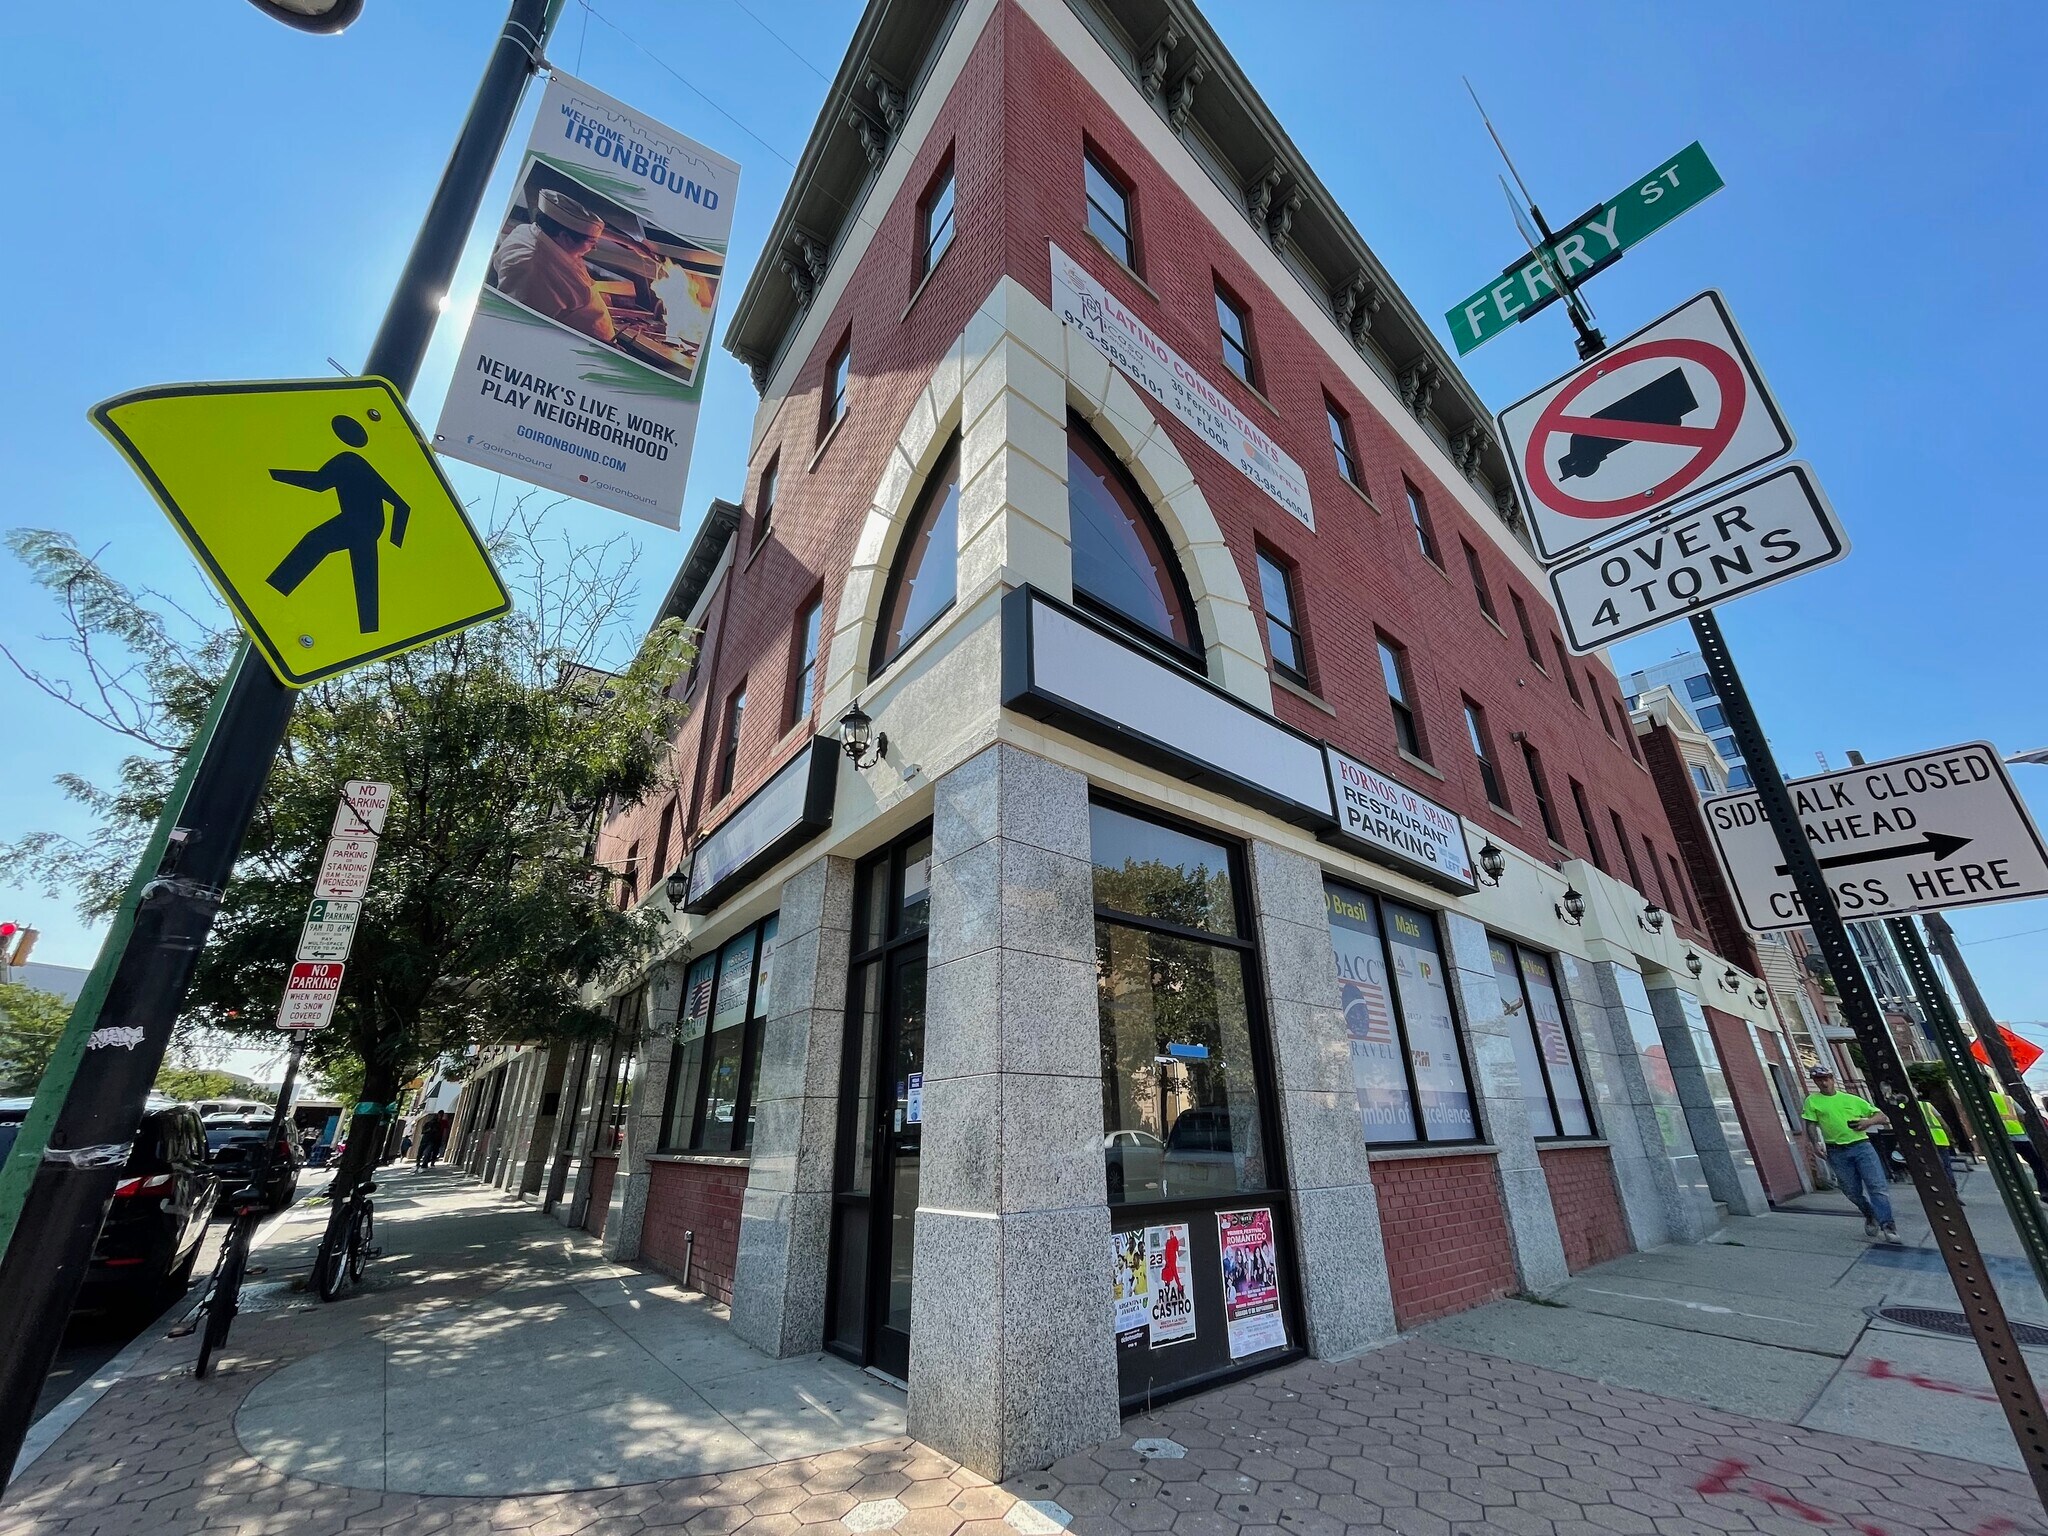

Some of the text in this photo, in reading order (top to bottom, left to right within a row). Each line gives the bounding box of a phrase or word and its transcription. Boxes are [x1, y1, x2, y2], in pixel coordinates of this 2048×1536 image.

[561, 104, 670, 167] WELCOME TO THE
[564, 118, 720, 212] IRONBOUND
[1464, 164, 1680, 340] FERRY ST
[1064, 309, 1164, 400] 973-589-6101
[1104, 295, 1280, 463] LATINO CONSULTANTS
[476, 354, 679, 448] NEWARK'S LIVE, WORK,
[1171, 379, 1184, 396] 39
[1186, 391, 1212, 422] Ferry
[480, 378, 669, 462] PLAY NEIGHBORHOOD
[1175, 397, 1182, 411] 3
[1197, 416, 1230, 453] FLOOR
[476, 439, 553, 470] /goironbound
[516, 424, 627, 473] GOIRONBOUND.COM
[590, 477, 658, 507] /goironbound
[1600, 504, 1756, 588] OVER
[1629, 528, 1802, 612] TONS
[347, 796, 386, 809] PARKING
[359, 785, 377, 796] NO
[1338, 760, 1456, 836] FORNOS OF SPAIN
[1714, 754, 1991, 830] SIDEALK CLOSED
[1343, 785, 1449, 848] RESTAURANT
[1805, 807, 1917, 845] AHEAD
[346, 842, 359, 851] NO
[1346, 806, 1438, 863] PARKING
[327, 862, 367, 873] STANDING
[332, 850, 368, 859] PARKING
[322, 878, 364, 887] WEDNESDAY
[1906, 859, 2021, 901] HERE
[313, 903, 349, 917] 2 HR
[324, 912, 356, 921] PARKING
[1333, 895, 1368, 923] Brasil
[1394, 914, 1421, 938] Mais
[308, 923, 352, 933] 9AM TO 6PM
[290, 976, 338, 989] PARKING
[311, 964, 329, 977] NO
[290, 993, 332, 1001] WHEN ROAD
[293, 1002, 324, 1010] IS SNOW
[289, 1011, 322, 1020] COVERED
[1351, 1041, 1395, 1060] RAVEL
[1398, 1101, 1411, 1124] of
[1422, 1102, 1471, 1124] xcellence
[1150, 1253, 1163, 1266] 23
[1152, 1298, 1192, 1320] CASTRO
[1157, 1285, 1185, 1304] RYAN
